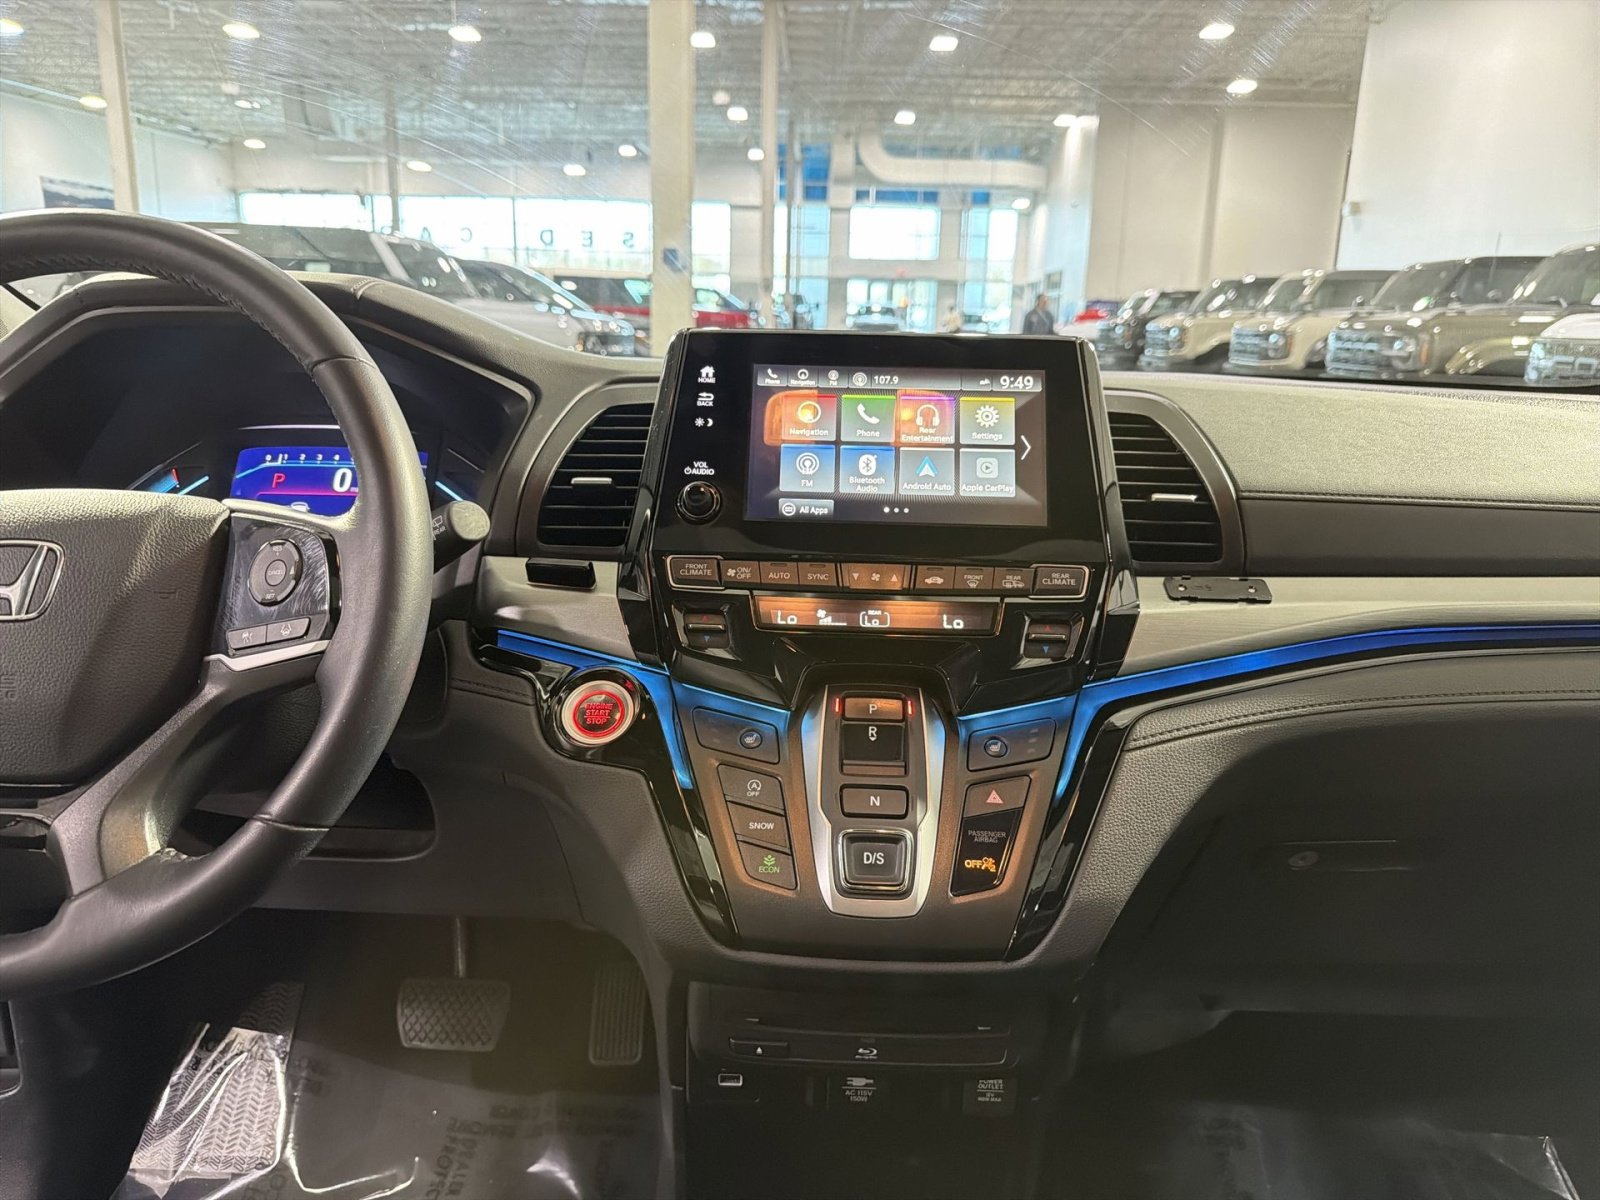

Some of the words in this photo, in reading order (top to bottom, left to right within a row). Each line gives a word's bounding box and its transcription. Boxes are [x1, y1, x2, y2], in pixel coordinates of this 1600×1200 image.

[873, 375, 899, 385] 107.9
[1000, 375, 1034, 389] 9:49
[789, 428, 829, 438] Navigation
[856, 430, 880, 438] Phone
[972, 432, 1003, 441] Settings
[901, 435, 954, 443] Entertainment
[272, 472, 286, 488] P
[333, 468, 352, 492] 0
[849, 476, 885, 484] Bluetooth
[902, 482, 931, 490] Android
[934, 483, 951, 491] Auto
[961, 484, 983, 493] Apple
[985, 484, 1014, 493] CarPlay
[800, 506, 808, 514] All
[810, 507, 828, 516] Apps
[680, 568, 712, 576] CLIMATE
[736, 572, 752, 580] OFF
[768, 572, 790, 580] AUTO
[807, 573, 829, 581] SYNC
[1042, 578, 1076, 586] CLIMATE
[776, 610, 798, 625] Lo
[943, 614, 964, 629] Lo
[585, 702, 614, 710] ENGINE
[868, 704, 878, 714] P
[868, 726, 877, 737] R
[870, 796, 880, 806] N
[748, 822, 775, 830] SNOW
[968, 830, 1006, 838] PASSENGER
[863, 852, 885, 865] D/S
[964, 859, 982, 868] OFF
